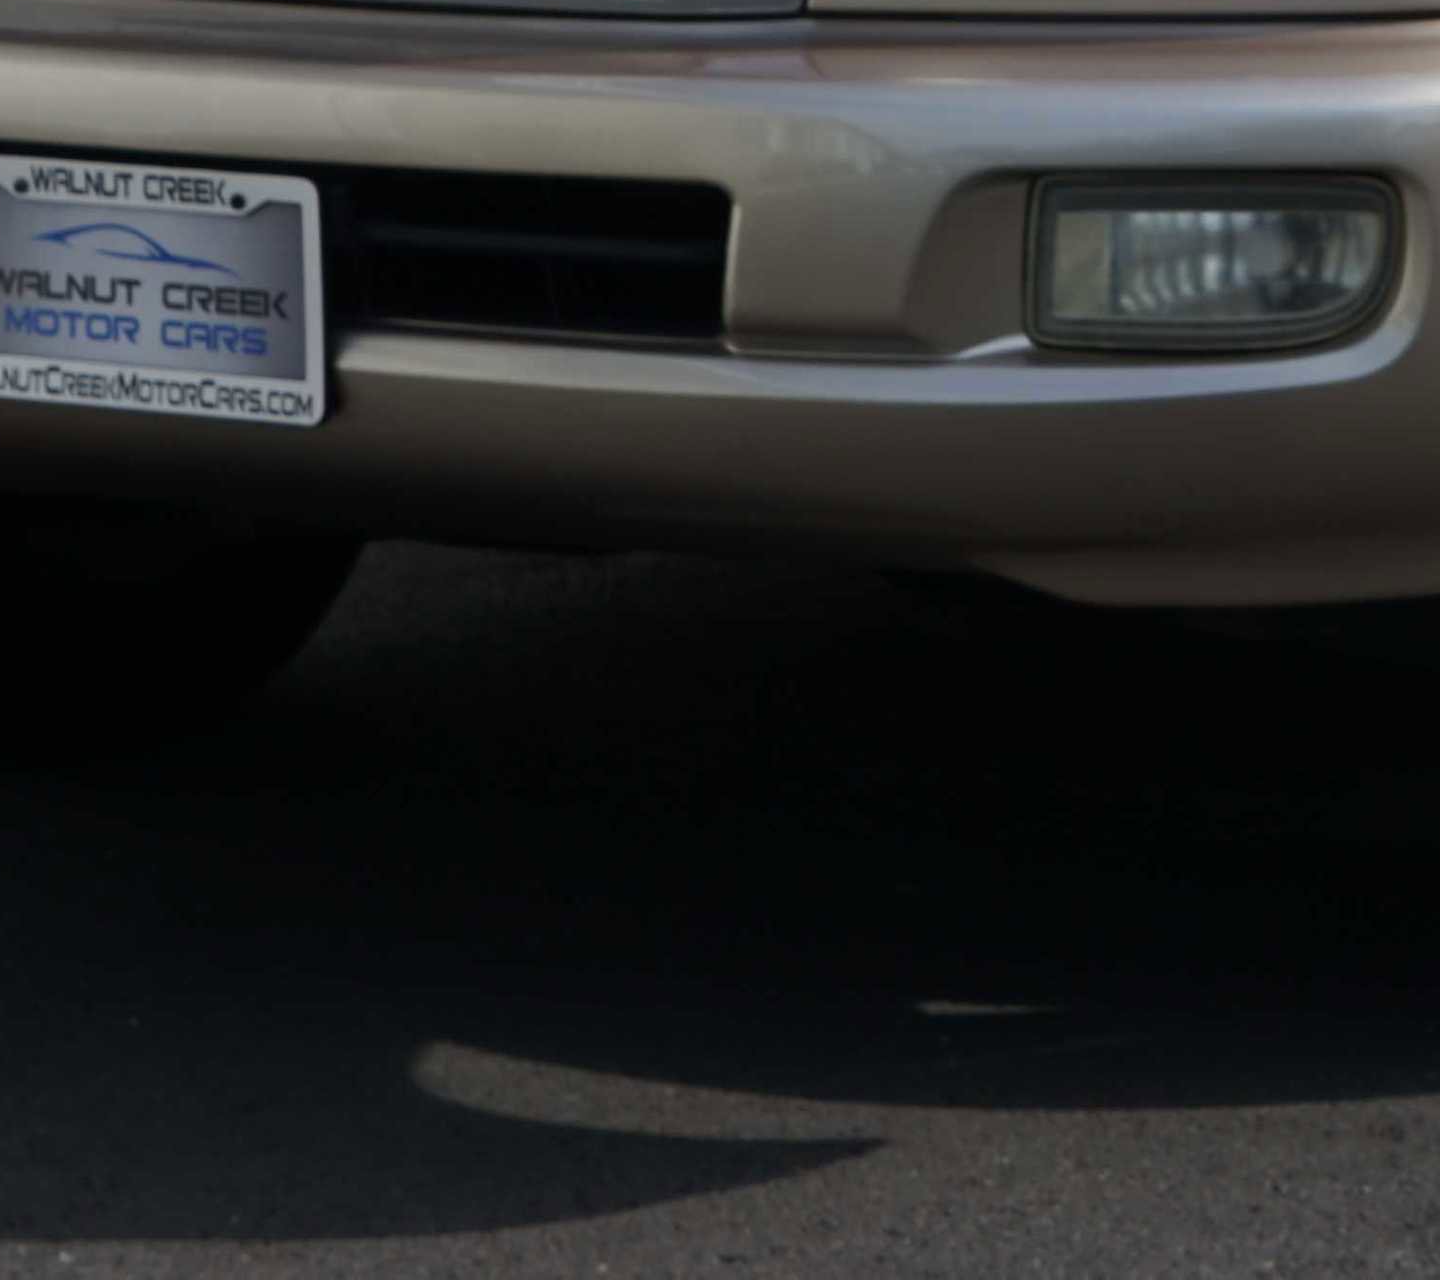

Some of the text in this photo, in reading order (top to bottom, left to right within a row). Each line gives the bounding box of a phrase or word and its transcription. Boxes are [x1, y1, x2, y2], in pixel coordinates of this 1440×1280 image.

[30, 165, 229, 207] WALNUT CREEK
[161, 281, 289, 320] CREEK
[3, 304, 270, 357] MOTOR CARS
